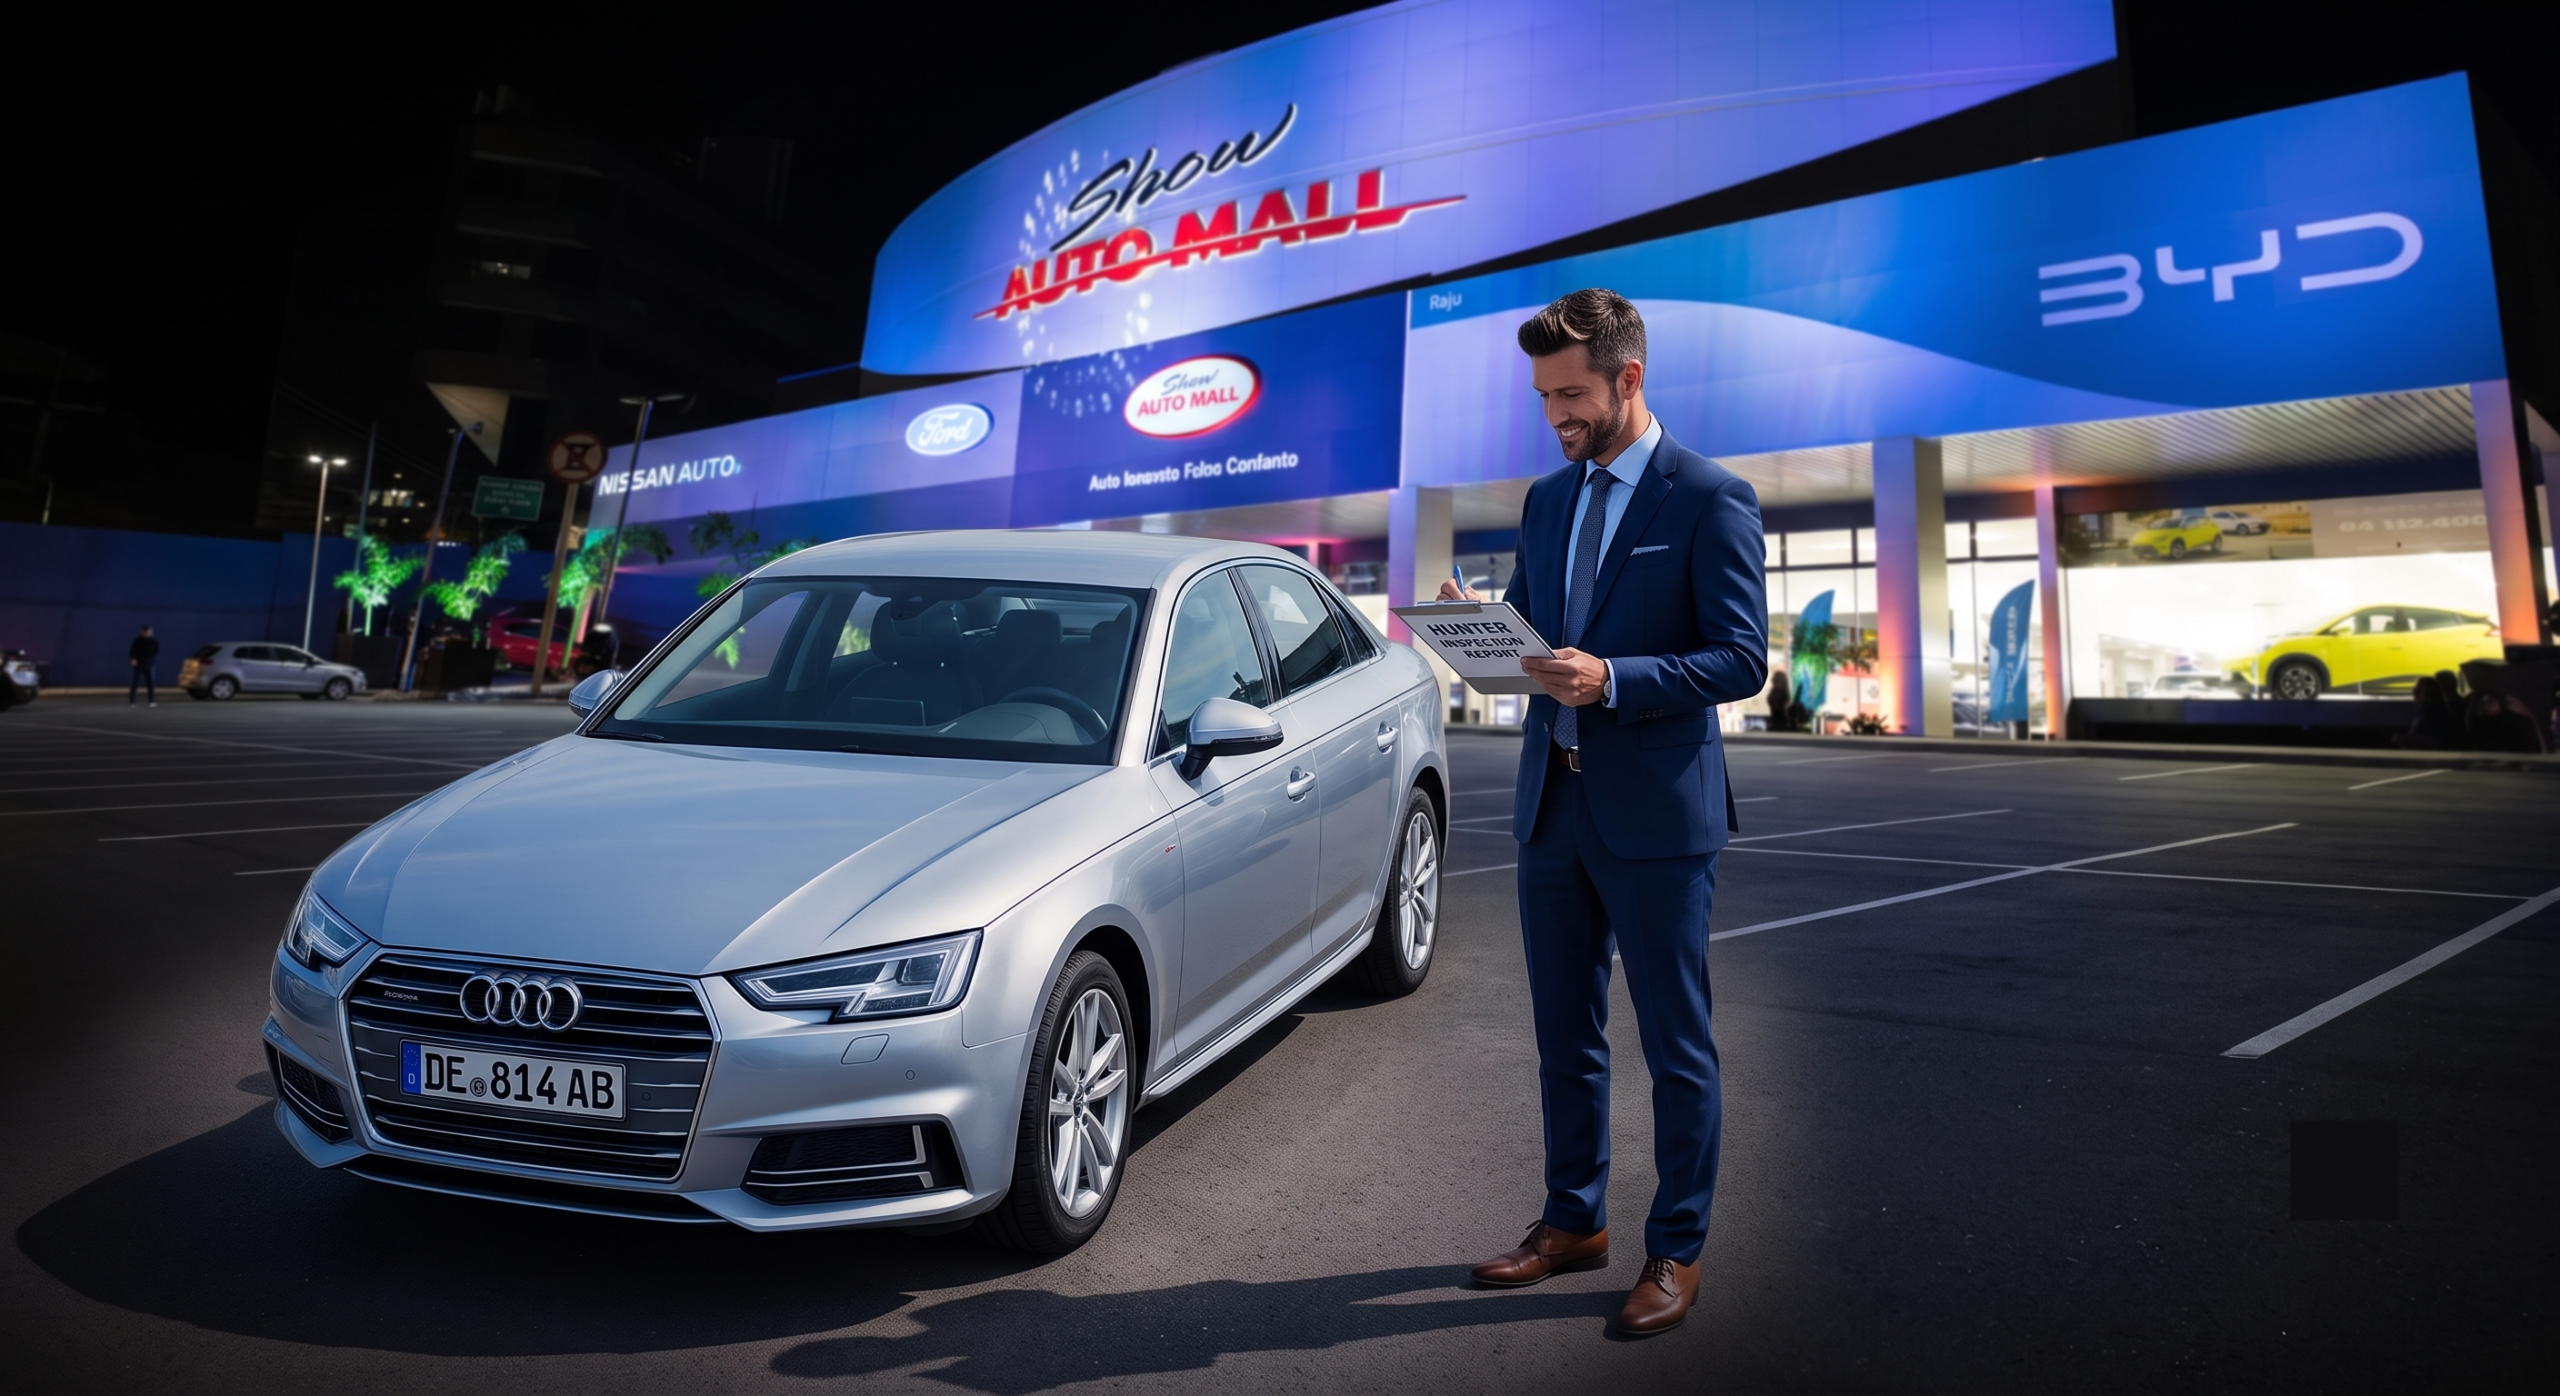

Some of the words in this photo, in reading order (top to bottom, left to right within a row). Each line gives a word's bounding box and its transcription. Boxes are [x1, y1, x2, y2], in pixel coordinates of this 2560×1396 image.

[1051, 103, 1297, 252] Show
[988, 226, 1154, 320] AUTO
[1170, 168, 1412, 270] MALL
[2038, 212, 2424, 327] BYD
[1136, 394, 1186, 418] AUTO
[1189, 386, 1240, 409] MALL
[918, 411, 974, 448] Ford
[598, 464, 675, 496] NISSAN
[676, 454, 736, 484] AUTO
[1088, 474, 1121, 492] Auto
[1426, 621, 1513, 636] HUNTER
[1439, 637, 1526, 649] INSPECTION
[424, 1052, 467, 1094] DE
[490, 1061, 557, 1105] 814
[566, 1068, 615, 1110] AB
